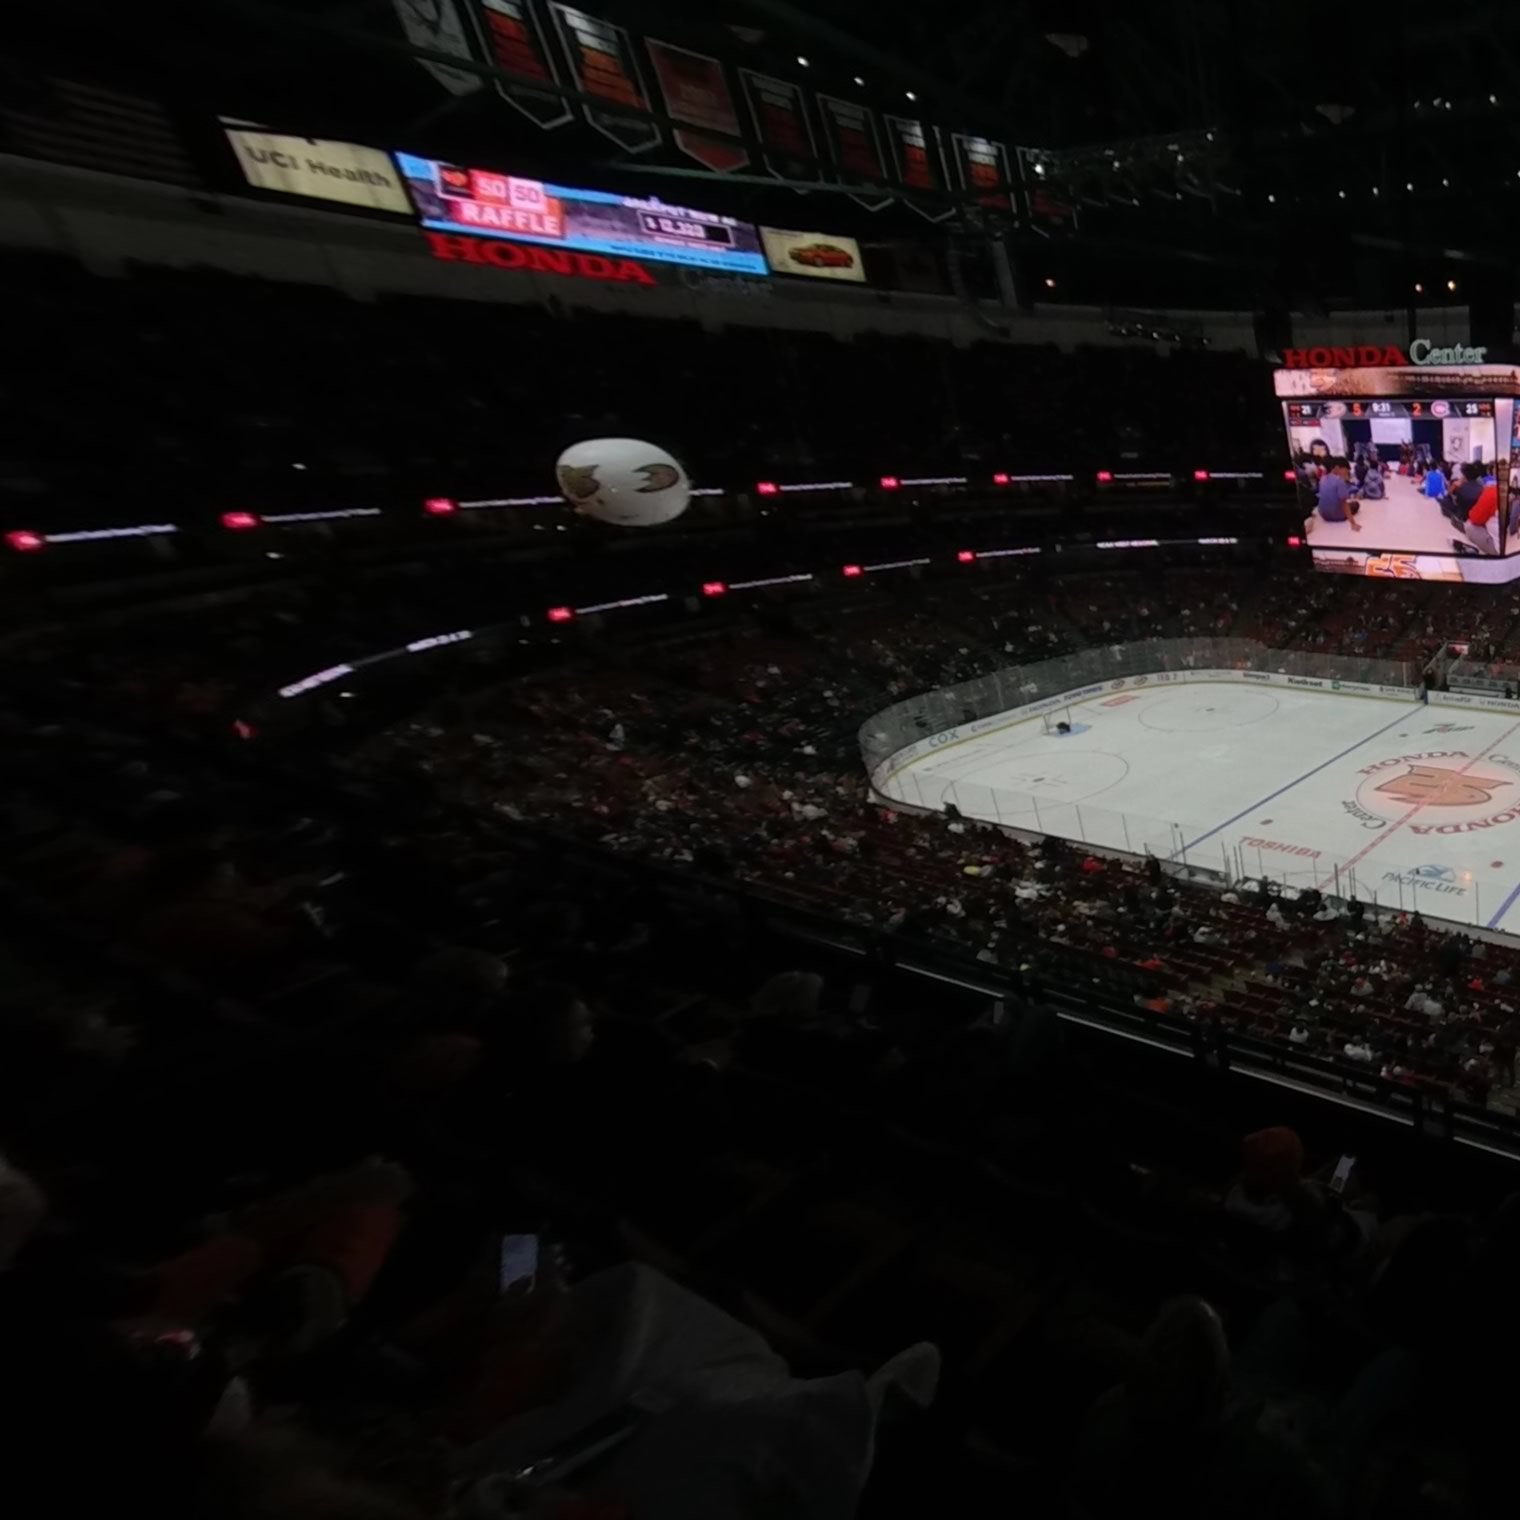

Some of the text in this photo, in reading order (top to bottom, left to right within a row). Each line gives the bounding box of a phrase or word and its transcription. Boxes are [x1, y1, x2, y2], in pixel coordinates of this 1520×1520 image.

[245, 145, 392, 188] UCI Health
[459, 203, 561, 233] RAFFLE
[430, 236, 656, 286] HONDA
[1283, 338, 1487, 367] HONDA Center
[928, 730, 960, 748] COX
[1356, 750, 1470, 776] HONDA
[1342, 799, 1388, 831] Center
[1239, 835, 1322, 860] TOSHIBA
[1382, 872, 1467, 897] PACIFIC LIFE
